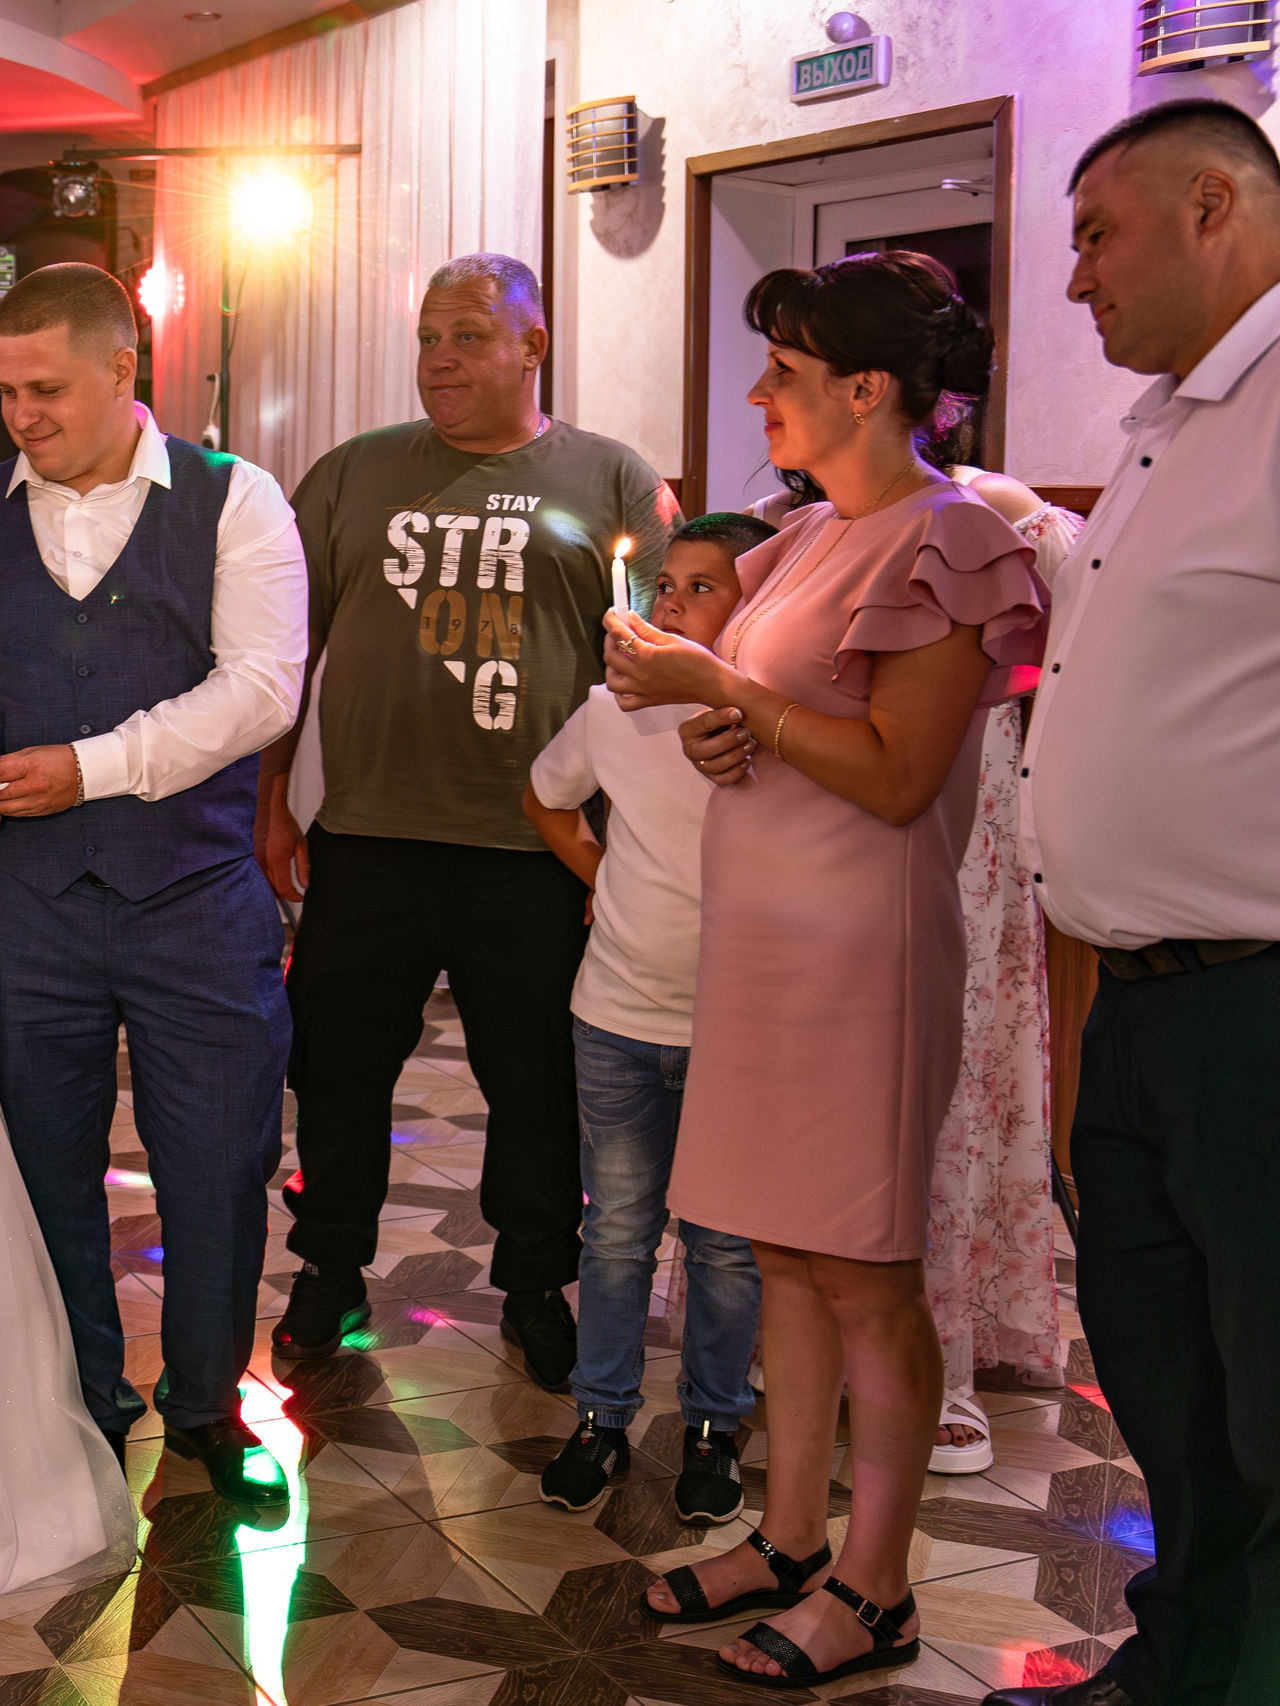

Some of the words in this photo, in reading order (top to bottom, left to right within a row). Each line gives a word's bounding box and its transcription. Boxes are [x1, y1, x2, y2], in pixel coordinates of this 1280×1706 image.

[799, 48, 871, 91] ВЫХОД
[486, 494, 541, 512] STAY
[383, 511, 530, 592] STR
[420, 589, 524, 660] ON
[472, 660, 518, 731] G
